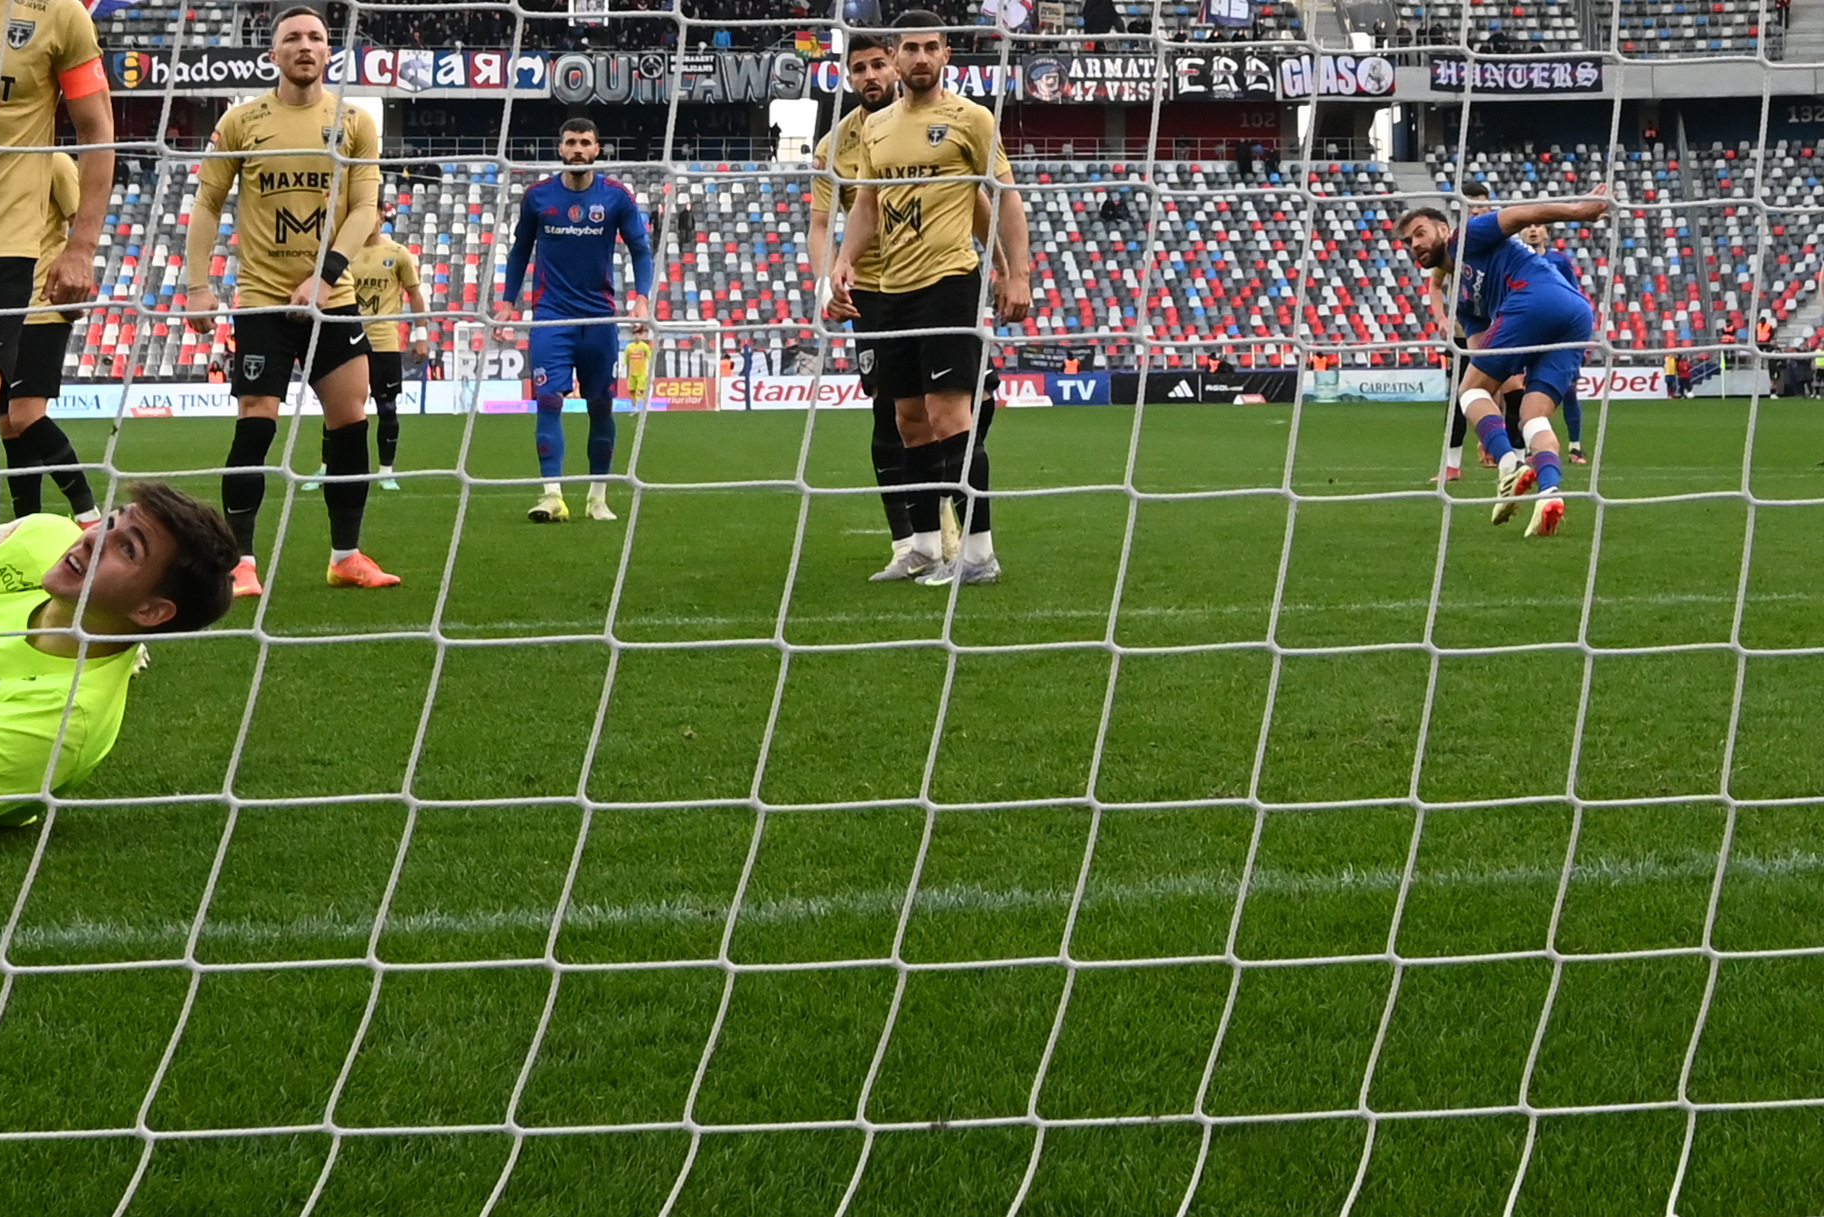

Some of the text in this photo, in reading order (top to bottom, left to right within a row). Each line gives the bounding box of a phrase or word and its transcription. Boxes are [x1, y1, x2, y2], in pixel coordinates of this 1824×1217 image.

[1069, 57, 1168, 78] ARMATA
[1071, 81, 1168, 102] 47 VEST
[259, 171, 334, 193] MAXBE
[544, 224, 604, 236] Stanleybet
[655, 381, 705, 397] casa
[729, 379, 872, 407] Stanleyb
[1056, 379, 1097, 401] TV
[1359, 381, 1425, 395] CARPATINA
[1576, 371, 1660, 396] eybet
[139, 394, 172, 408] APA
